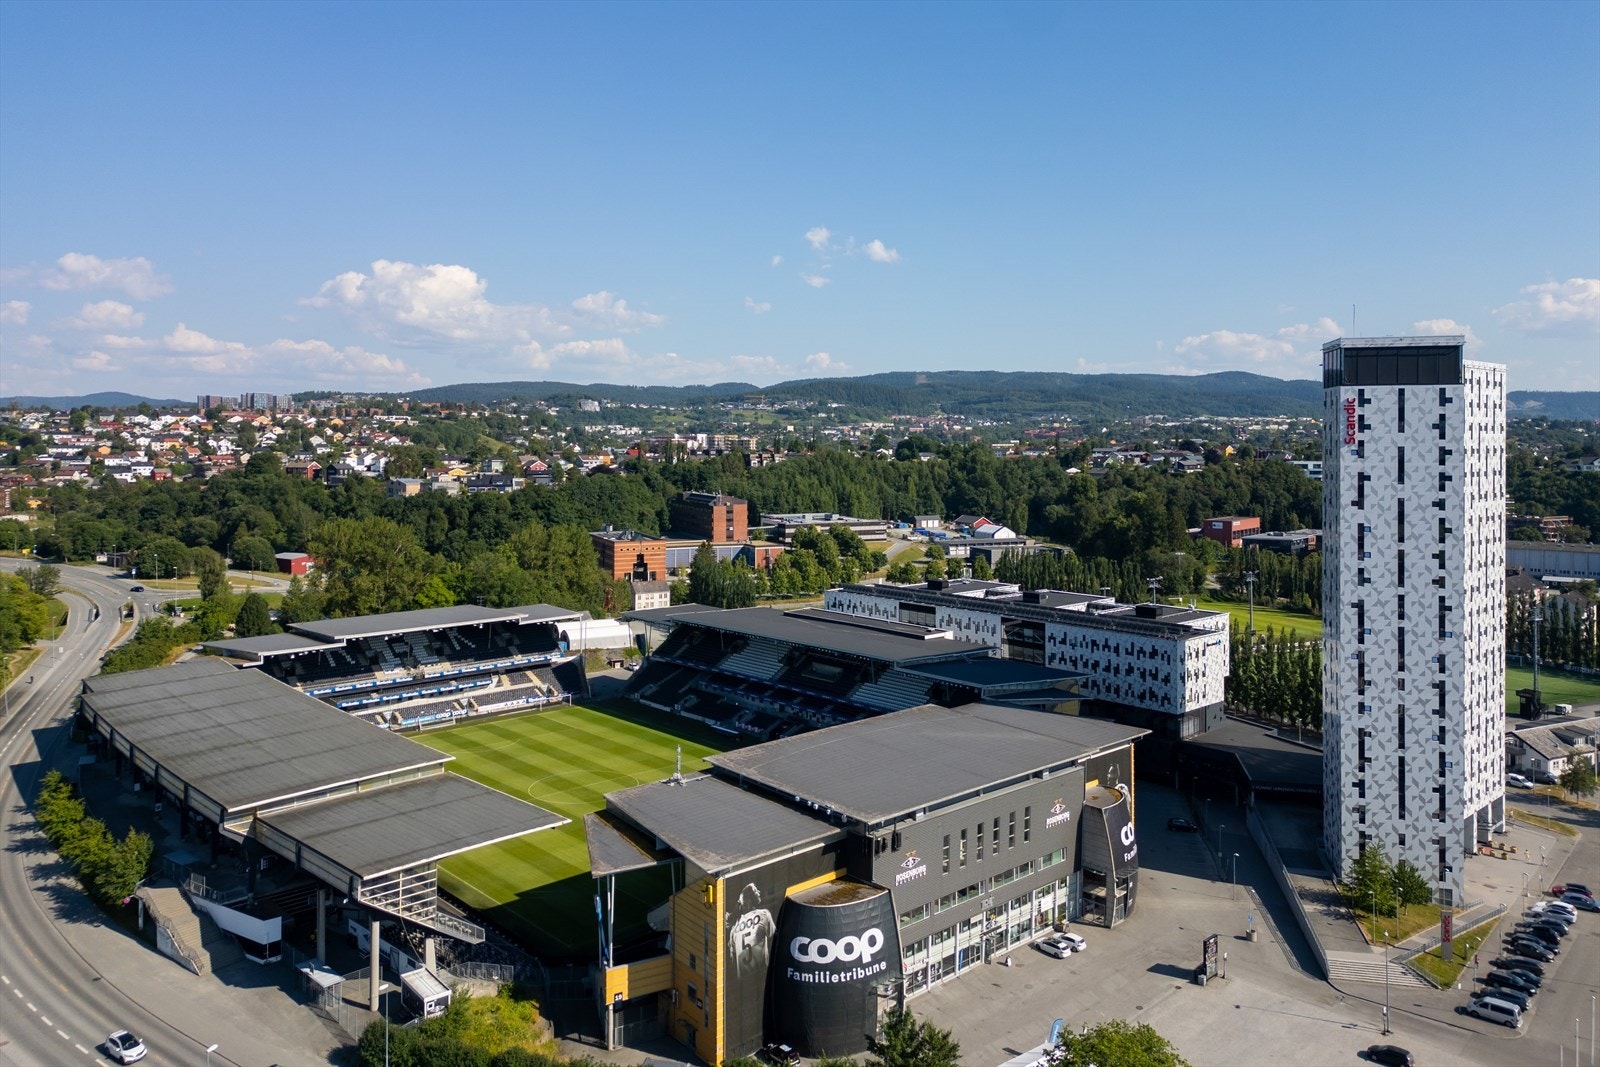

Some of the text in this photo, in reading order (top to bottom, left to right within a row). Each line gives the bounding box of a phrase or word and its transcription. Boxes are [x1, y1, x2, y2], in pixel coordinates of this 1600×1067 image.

[1344, 398, 1356, 445] Scandic
[895, 864, 927, 883] ROSENBORG
[734, 914, 761, 933] coop
[741, 931, 753, 964] 5
[789, 927, 884, 964] coop
[787, 960, 887, 984] Familietribune
